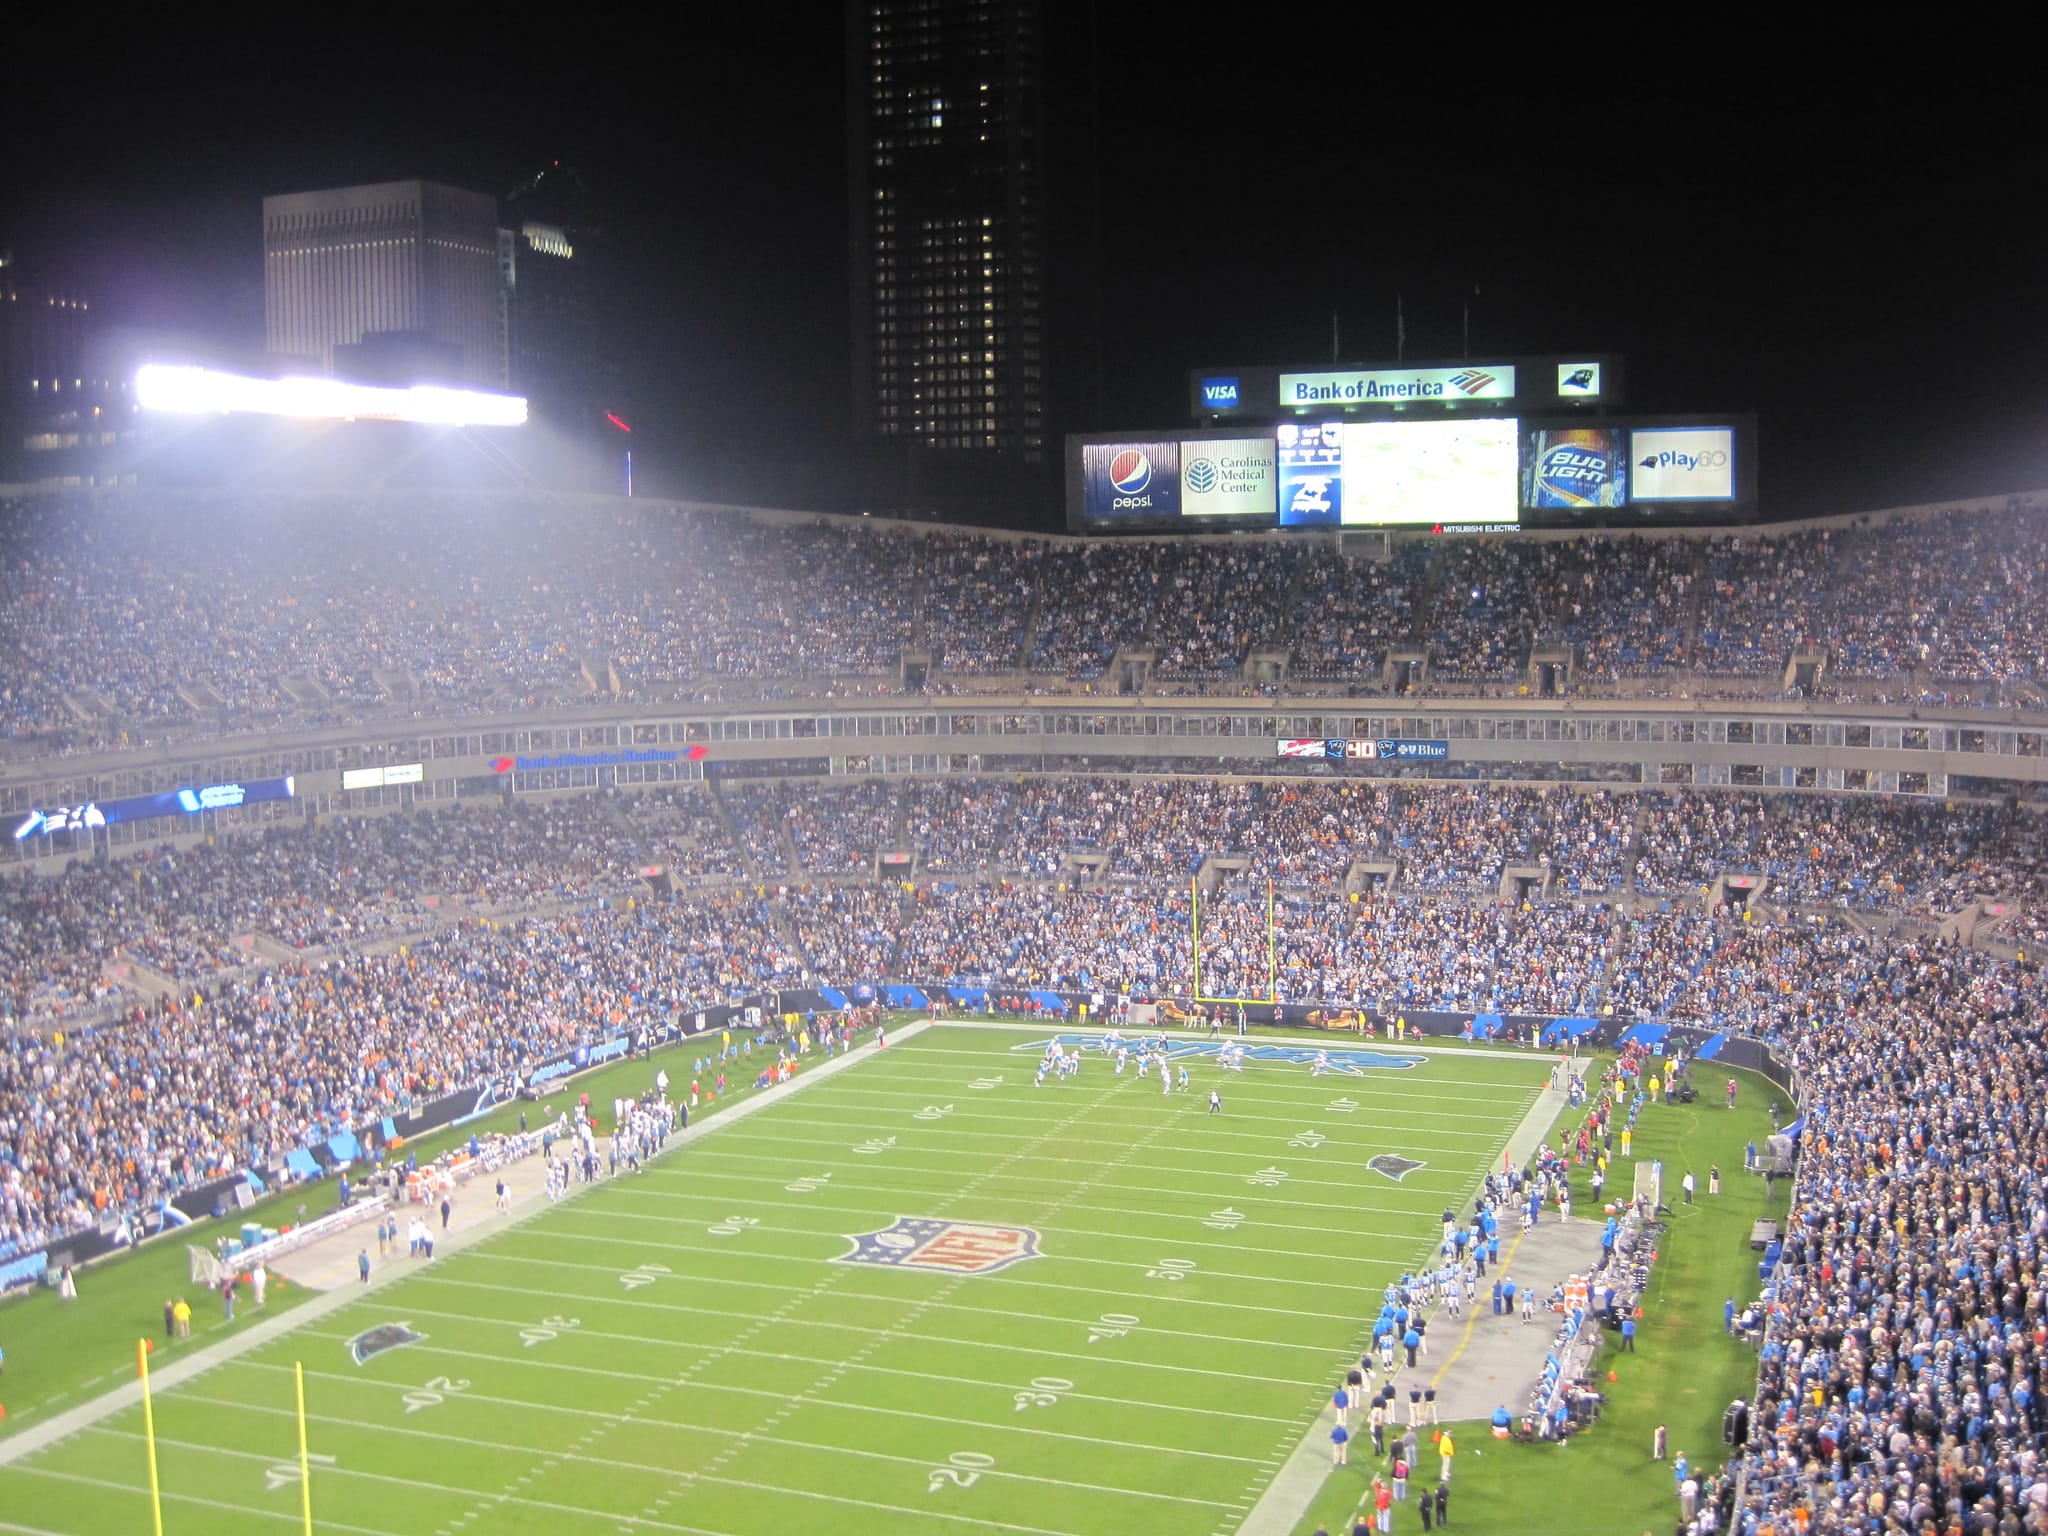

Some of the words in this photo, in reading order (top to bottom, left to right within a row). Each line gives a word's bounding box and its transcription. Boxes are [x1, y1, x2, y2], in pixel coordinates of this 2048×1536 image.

[1204, 386, 1237, 399] VISA
[1296, 382, 1341, 400] Bank
[1341, 380, 1364, 398] of
[1366, 379, 1443, 397] America
[1220, 457, 1272, 468] Carolinas
[1550, 452, 1606, 470] BUD
[1220, 469, 1265, 480] Medical
[1539, 465, 1607, 483] LIGHT
[1220, 482, 1257, 493] Center
[1113, 495, 1150, 510] pepsi
[1443, 525, 1484, 533] MITSUBISHI
[1485, 524, 1520, 533] ELECTRIC
[1418, 744, 1446, 756] Blue
[908, 1230, 1020, 1270] NFL
[1013, 1377, 1073, 1407] 30
[929, 1452, 995, 1488] 20
